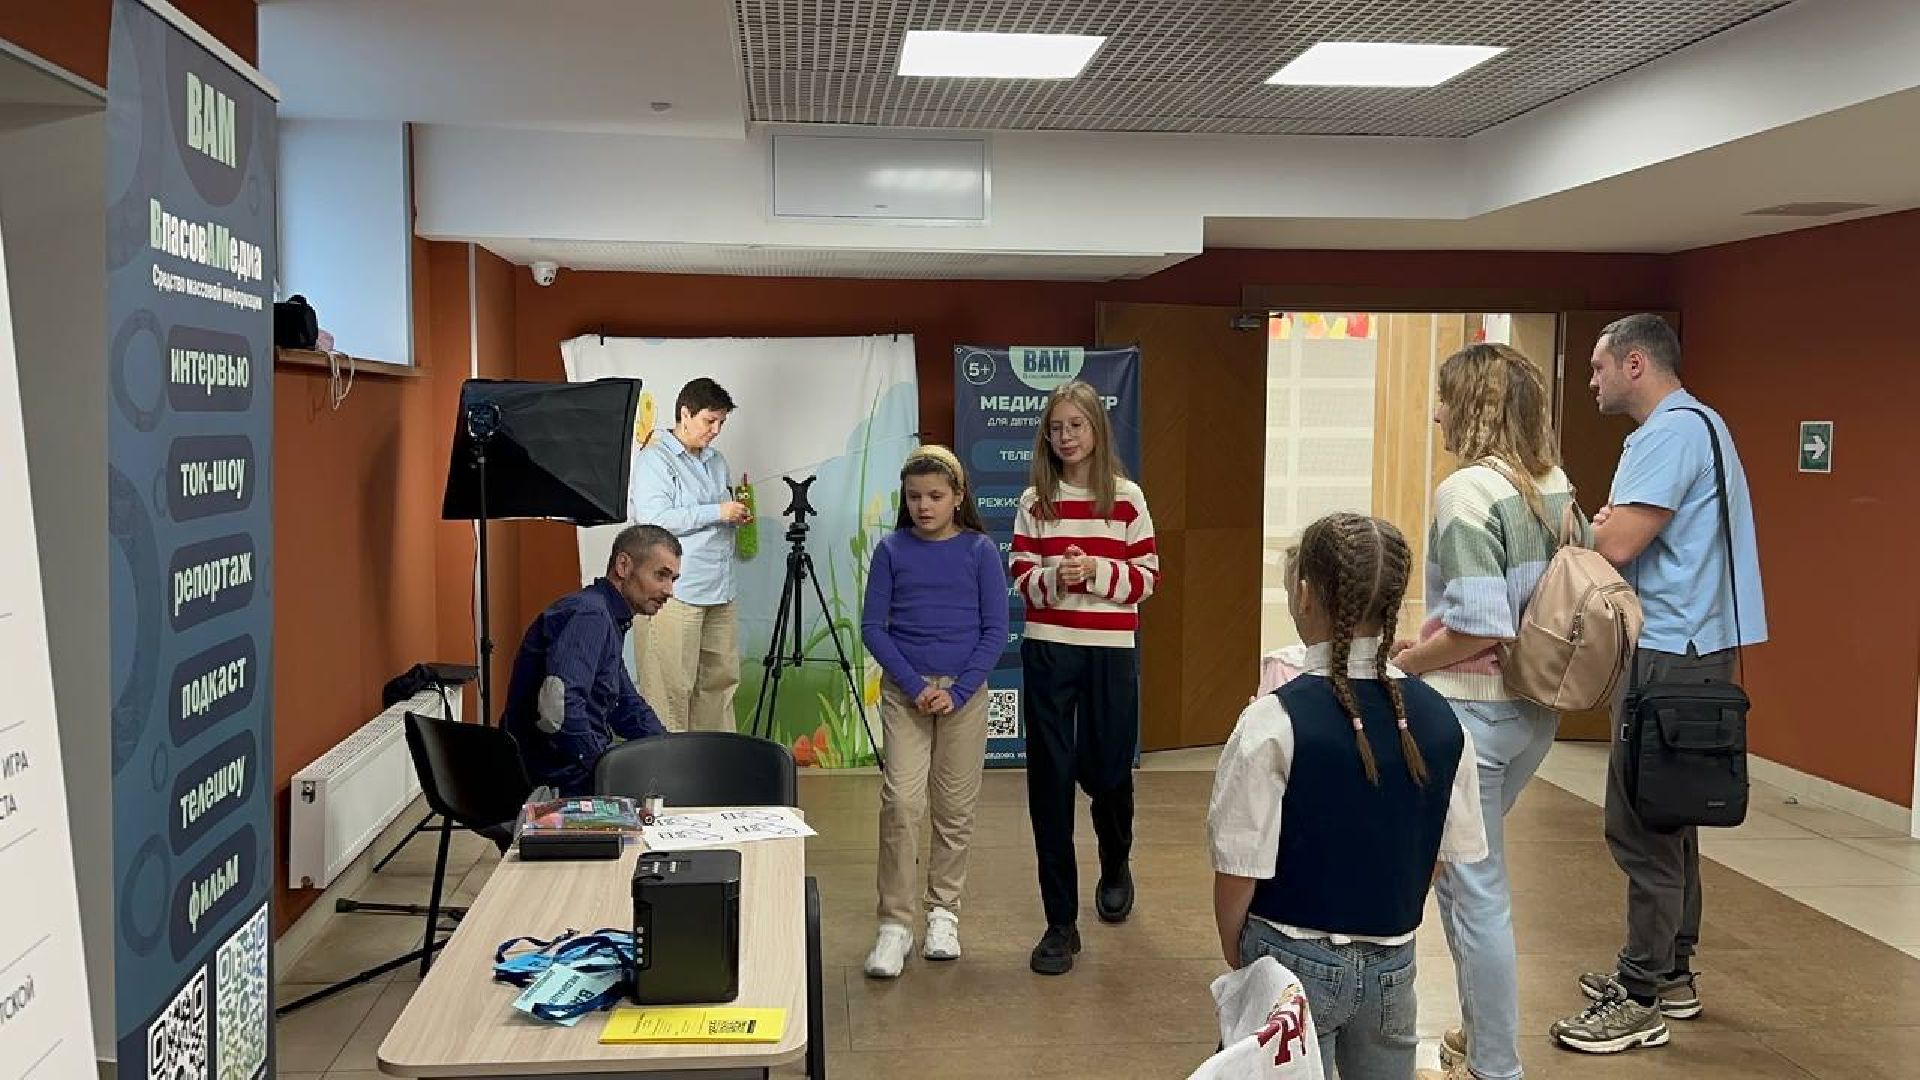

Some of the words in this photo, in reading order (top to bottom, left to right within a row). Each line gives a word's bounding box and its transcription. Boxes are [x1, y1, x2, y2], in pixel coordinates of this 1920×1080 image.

[187, 72, 236, 168] ВАМ
[150, 198, 262, 282] ВласовАМедиа
[171, 348, 249, 395] интервью
[969, 362, 991, 377] 5+
[1023, 349, 1069, 373] ВАМ
[181, 458, 245, 499] ток-шоу
[1000, 450, 1034, 461] ТЕЛЕ
[174, 552, 252, 616] репортаж
[181, 657, 246, 720] подкаст
[2, 750, 29, 780] ИГРА
[180, 756, 246, 829] телешоу
[188, 854, 239, 934] фильм
